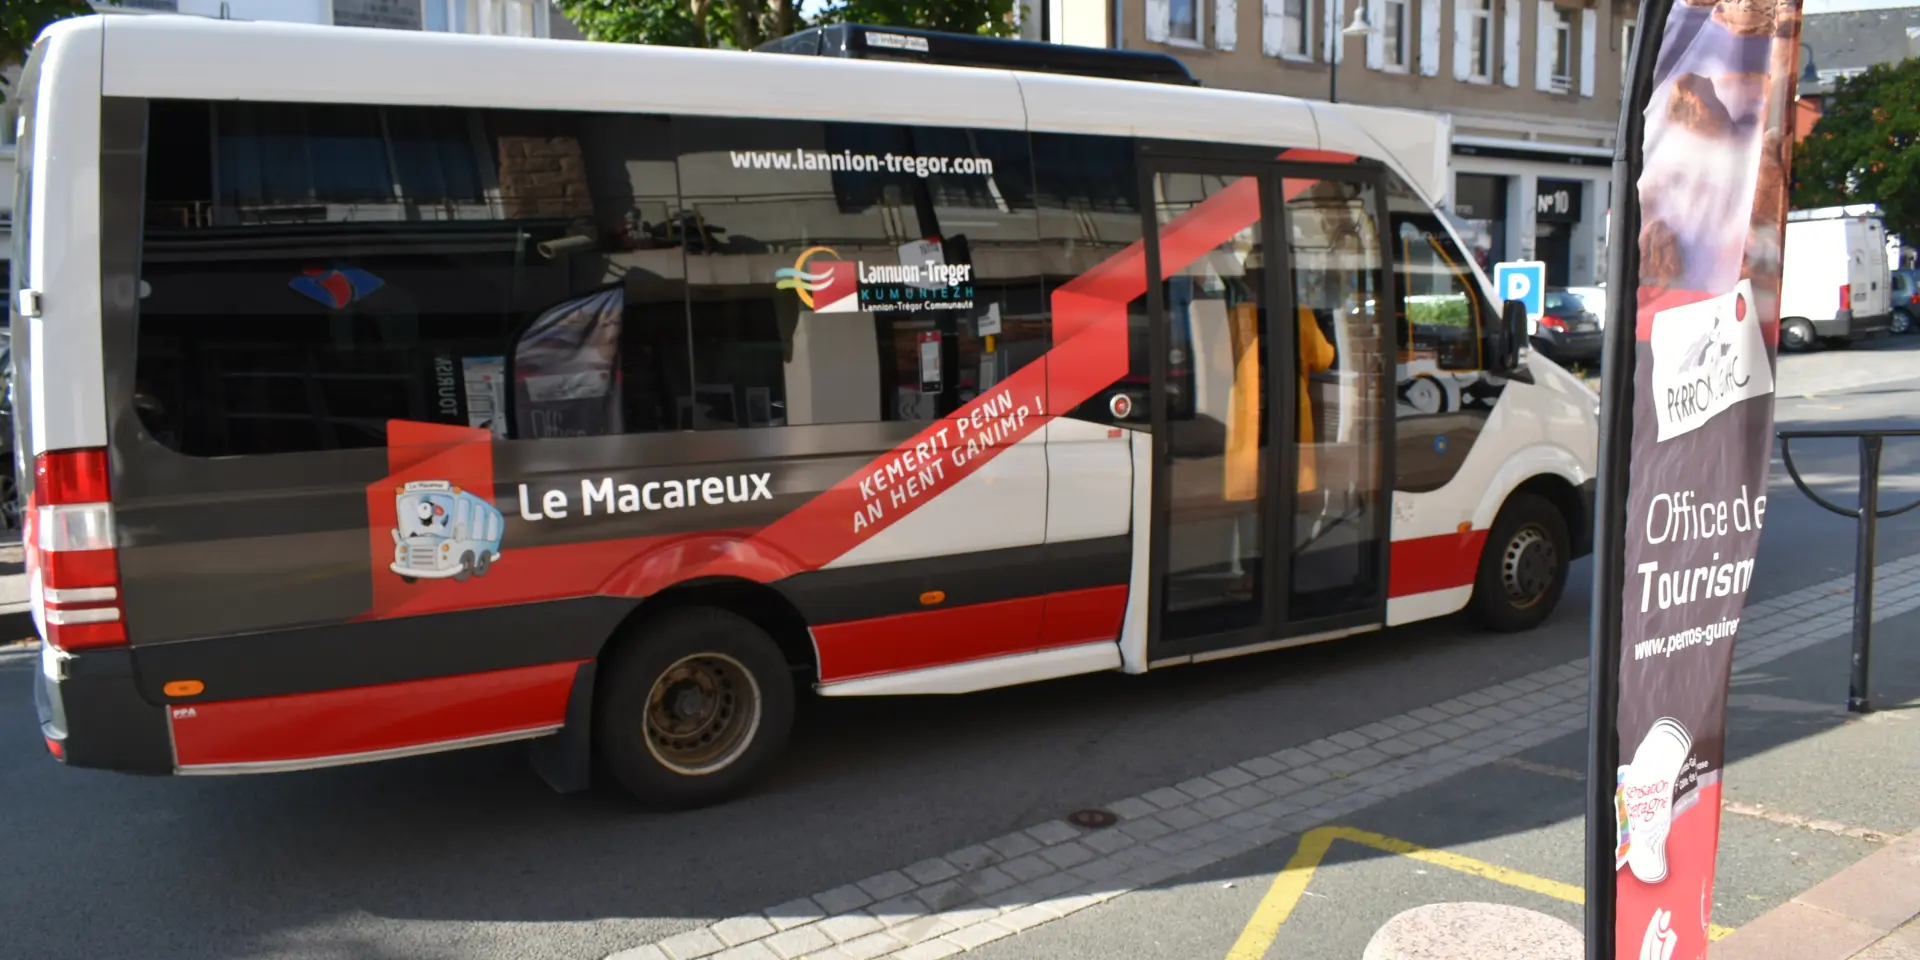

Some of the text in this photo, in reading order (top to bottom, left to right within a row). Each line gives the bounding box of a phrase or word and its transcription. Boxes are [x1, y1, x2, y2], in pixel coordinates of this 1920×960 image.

[730, 148, 993, 178] www.lannion-tregor.com
[858, 260, 971, 286] Lannuon-Treger
[1508, 273, 1530, 300] P
[862, 300, 974, 312] Lannion-Trégor Communauté
[859, 389, 1013, 500] KEMERIT PENN
[853, 498, 883, 533] AN
[890, 458, 945, 509] HENT
[951, 405, 1029, 467] GANIMP
[519, 472, 773, 520] Le Macareux
[1646, 485, 1767, 544] Office de
